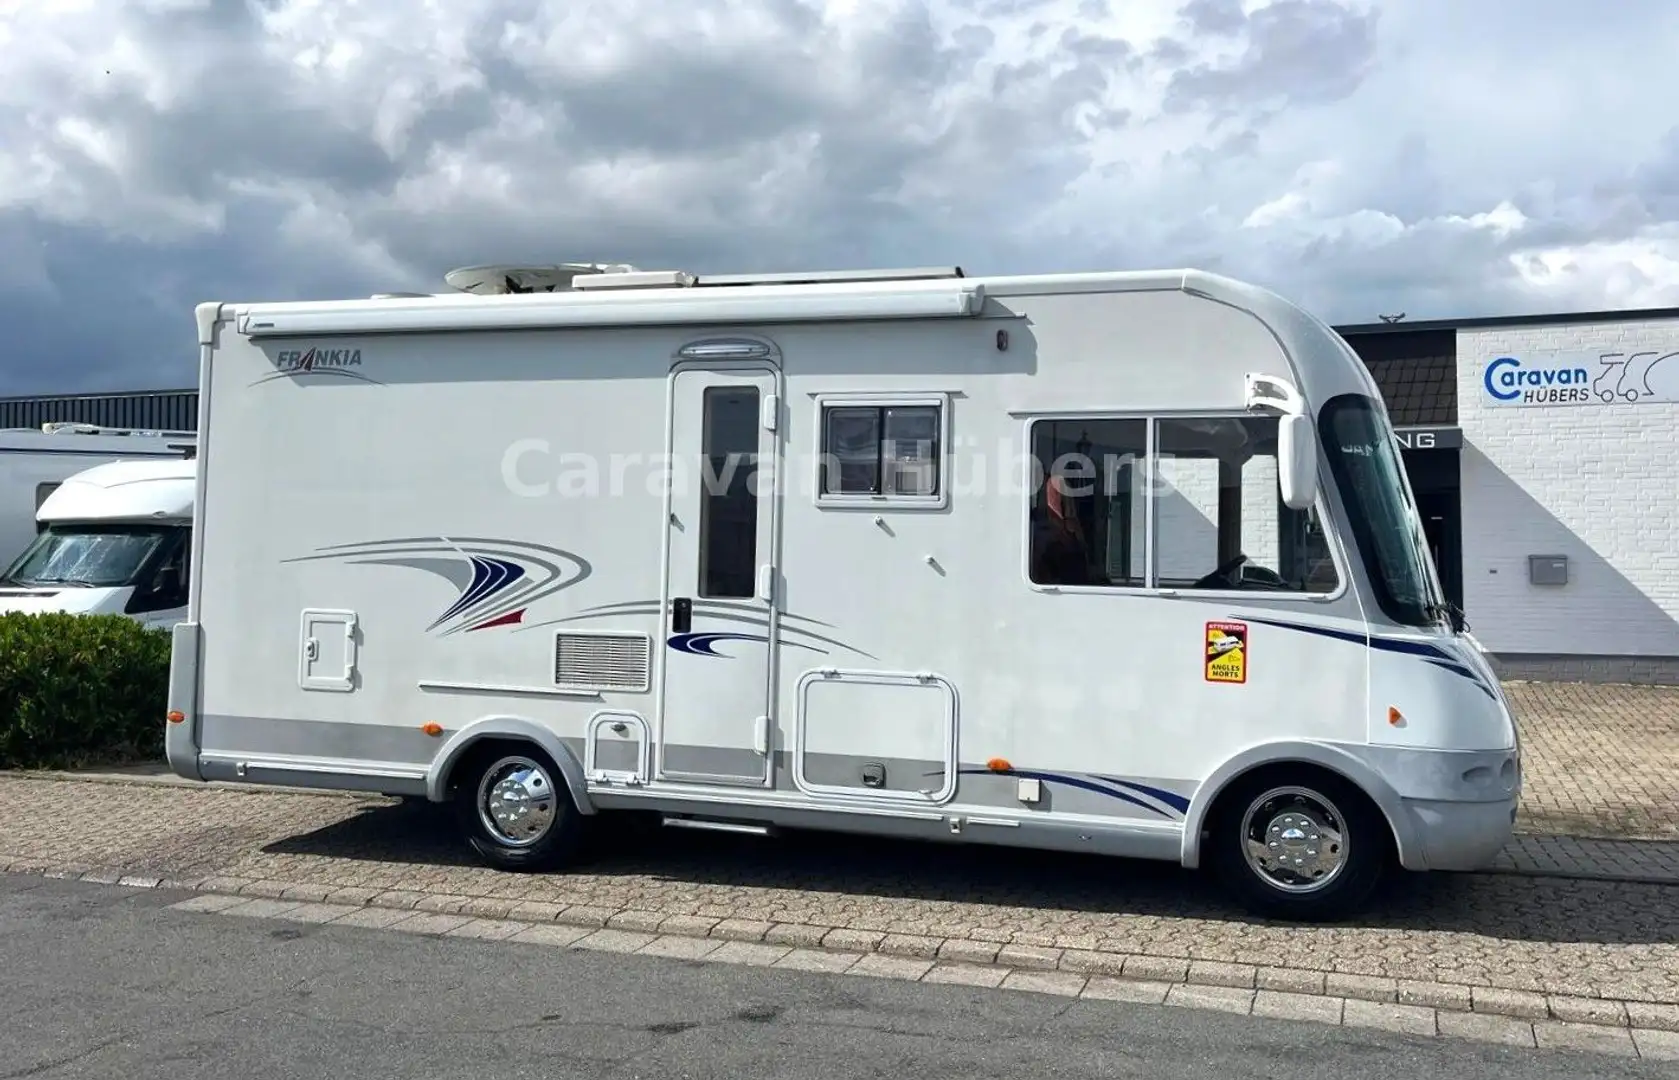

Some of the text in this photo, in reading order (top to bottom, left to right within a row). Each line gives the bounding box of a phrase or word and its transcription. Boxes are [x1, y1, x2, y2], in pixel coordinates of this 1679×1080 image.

[276, 346, 362, 371] FRANKIA
[1484, 357, 1588, 400] Caravan
[1523, 386, 1589, 403] HÜBERS
[1211, 663, 1240, 671] ANGLES
[1212, 670, 1239, 678] MORTS
